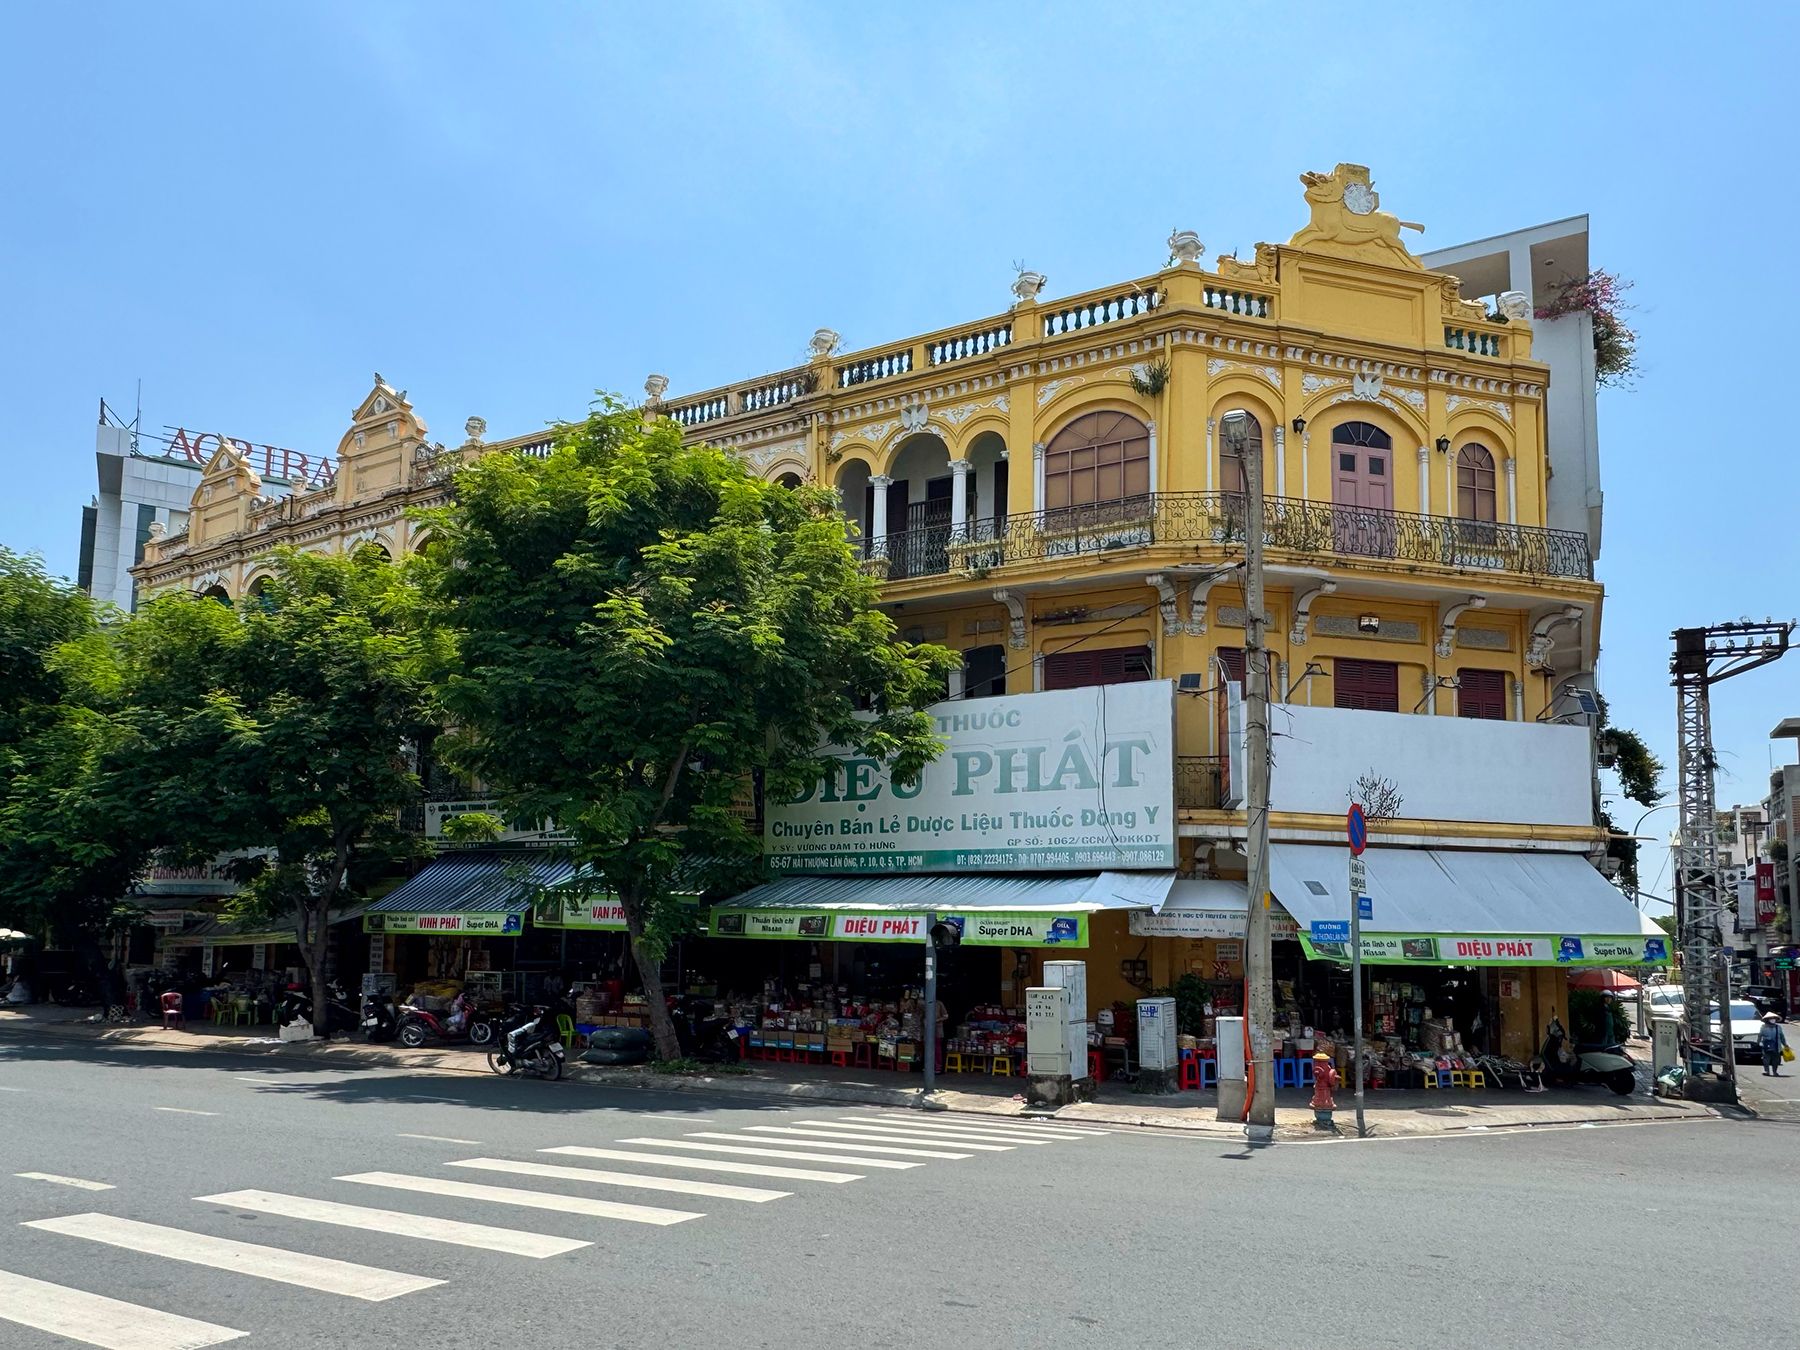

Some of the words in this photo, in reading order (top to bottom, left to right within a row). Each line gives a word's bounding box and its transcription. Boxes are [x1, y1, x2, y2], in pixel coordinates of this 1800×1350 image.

[937, 704, 1021, 733] THUỐC
[952, 728, 1151, 796] PHÁT
[772, 820, 834, 839] Chuyên
[840, 817, 873, 834] Bán
[879, 814, 900, 834] Lẻ
[907, 815, 954, 837] Dược
[961, 813, 1002, 835] Liệu
[1009, 807, 1074, 829] Thuốc
[1144, 806, 1160, 824] Y
[1007, 838, 1021, 846] GP
[770, 856, 791, 868] 65-67
[860, 857, 867, 867] P.
[907, 855, 923, 866] HCM
[984, 854, 1013, 865] 22234175
[419, 917, 438, 929] VINH
[439, 915, 462, 929] PHÁT
[466, 921, 484, 929] Super
[844, 917, 877, 936] DIỆU
[882, 916, 919, 935] PHÁT
[978, 925, 1007, 938] Super
[1010, 926, 1033, 936] DHA
[1456, 939, 1492, 959] DIỆU
[1496, 939, 1533, 957] PHÁT
[1593, 946, 1616, 957] Super
[1617, 946, 1633, 955] DHA
